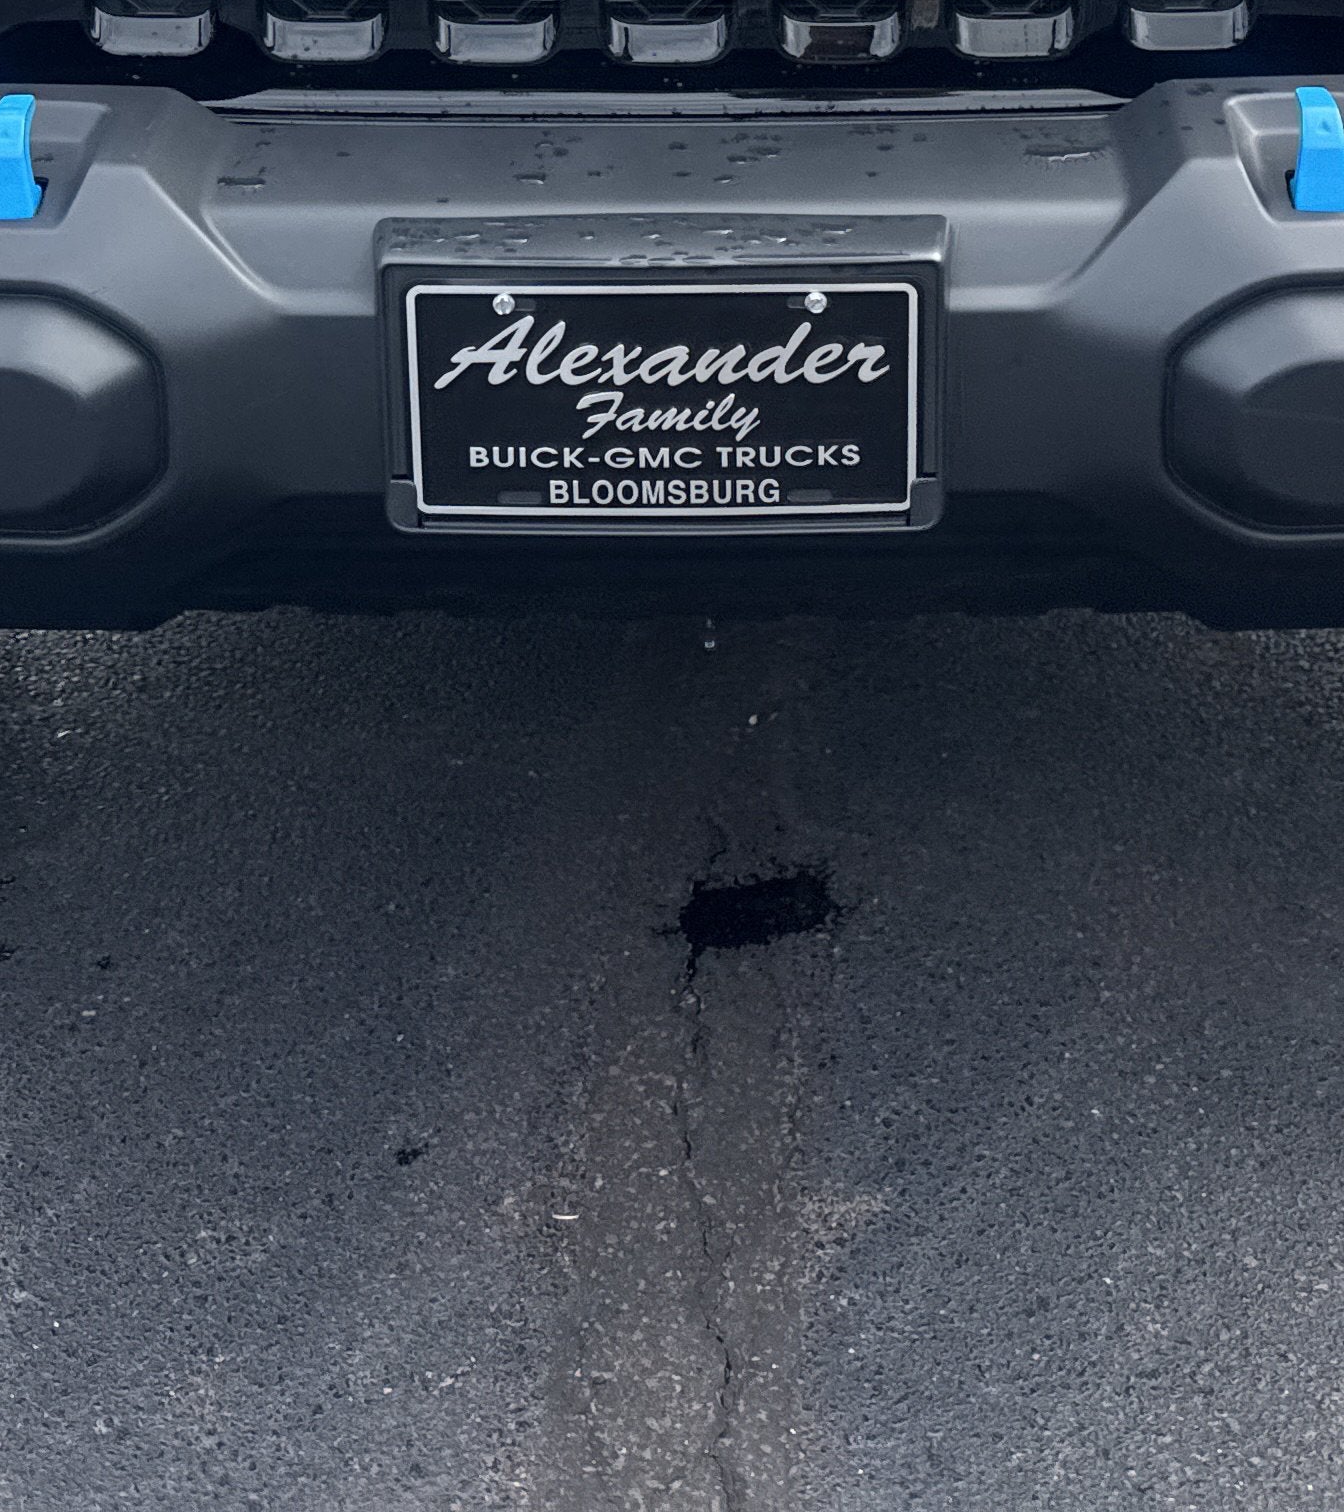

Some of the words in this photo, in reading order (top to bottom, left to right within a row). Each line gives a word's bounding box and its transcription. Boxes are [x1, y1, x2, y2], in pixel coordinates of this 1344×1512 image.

[433, 314, 891, 390] Alexander
[575, 391, 761, 442] Family
[468, 445, 703, 469] BUICK-GMC
[715, 444, 862, 468] TRUCKS
[548, 478, 781, 505] BLOOMSBURG
